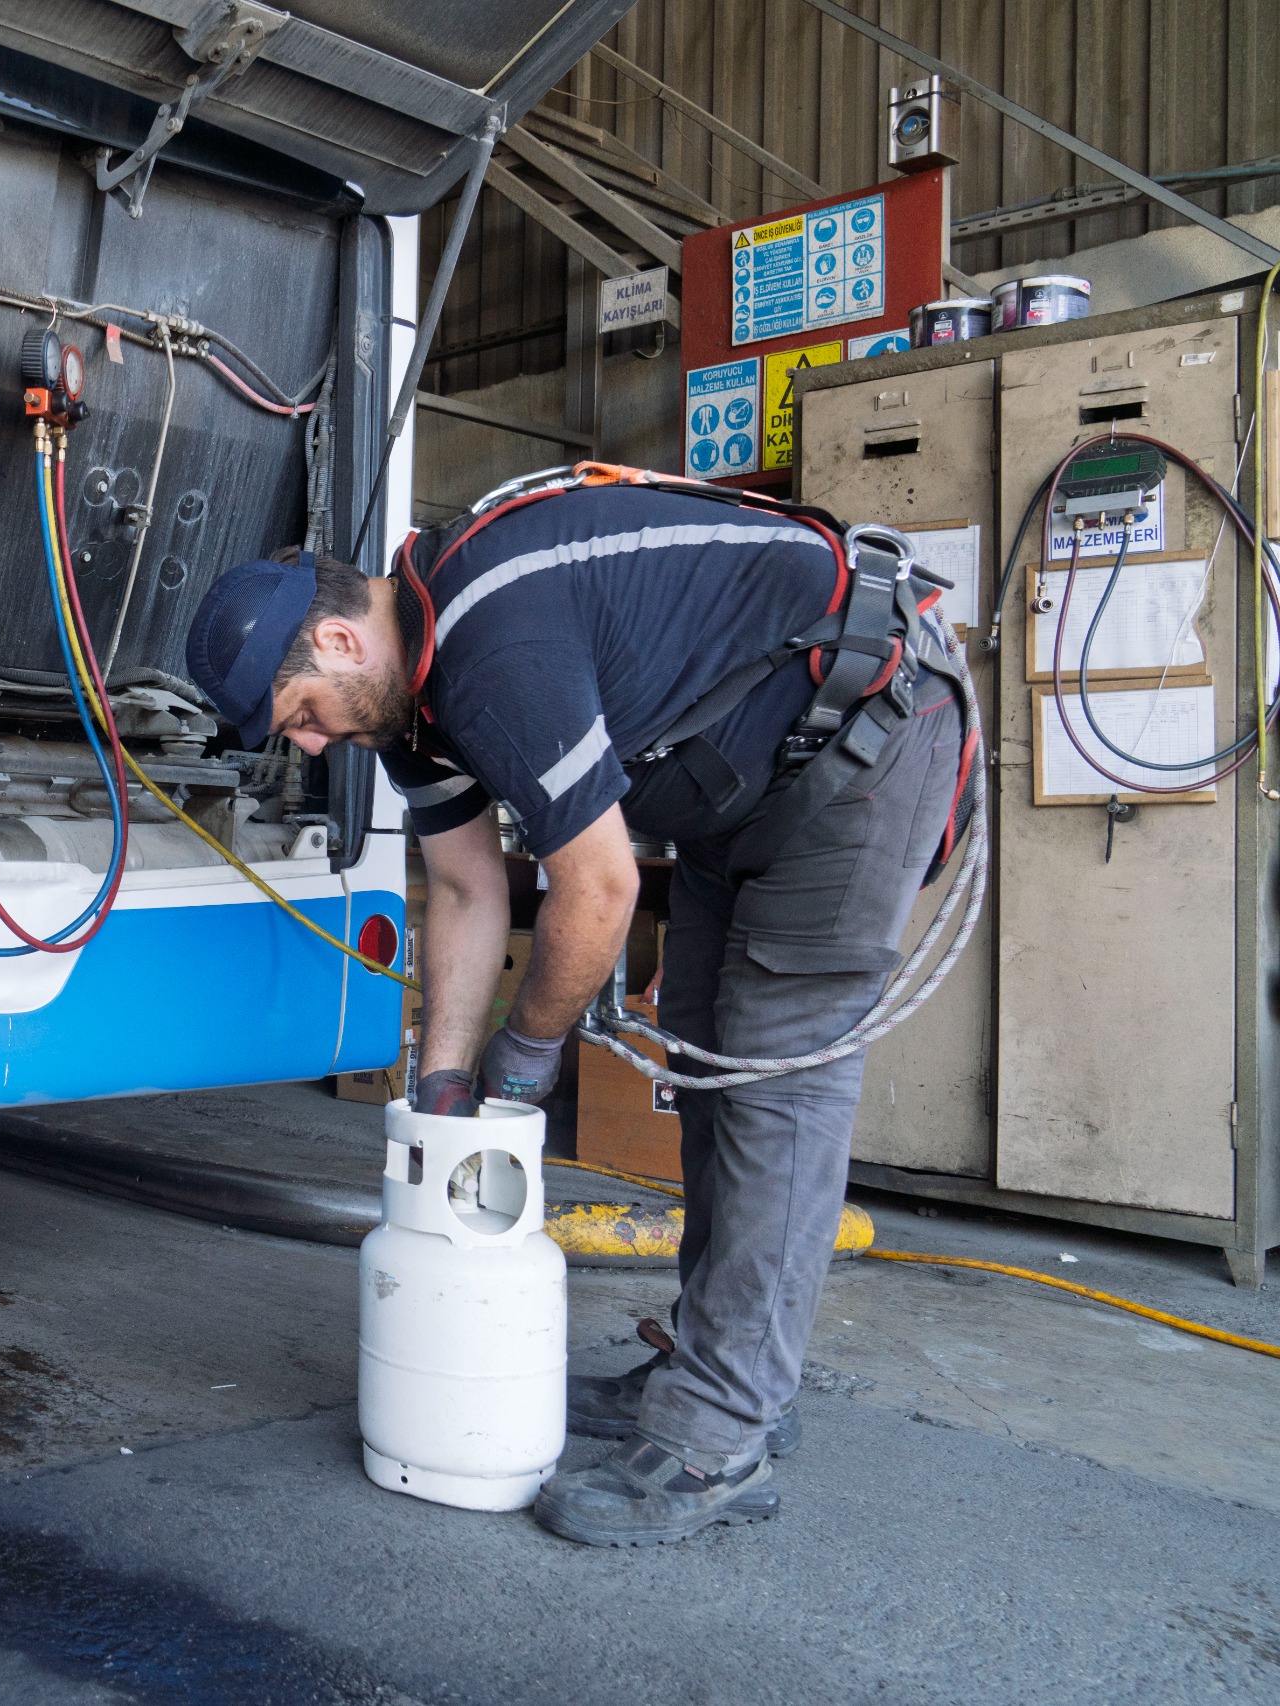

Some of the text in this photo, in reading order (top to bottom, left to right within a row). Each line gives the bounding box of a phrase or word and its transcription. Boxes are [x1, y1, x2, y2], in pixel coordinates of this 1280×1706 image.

[616, 282, 652, 300] KLİMA
[604, 299, 663, 323] KAYIŞLARI
[702, 365, 743, 382] KORUYUCU
[690, 375, 755, 395] MALZEME KULLAN
[407, 1066, 417, 1094] Otokar
